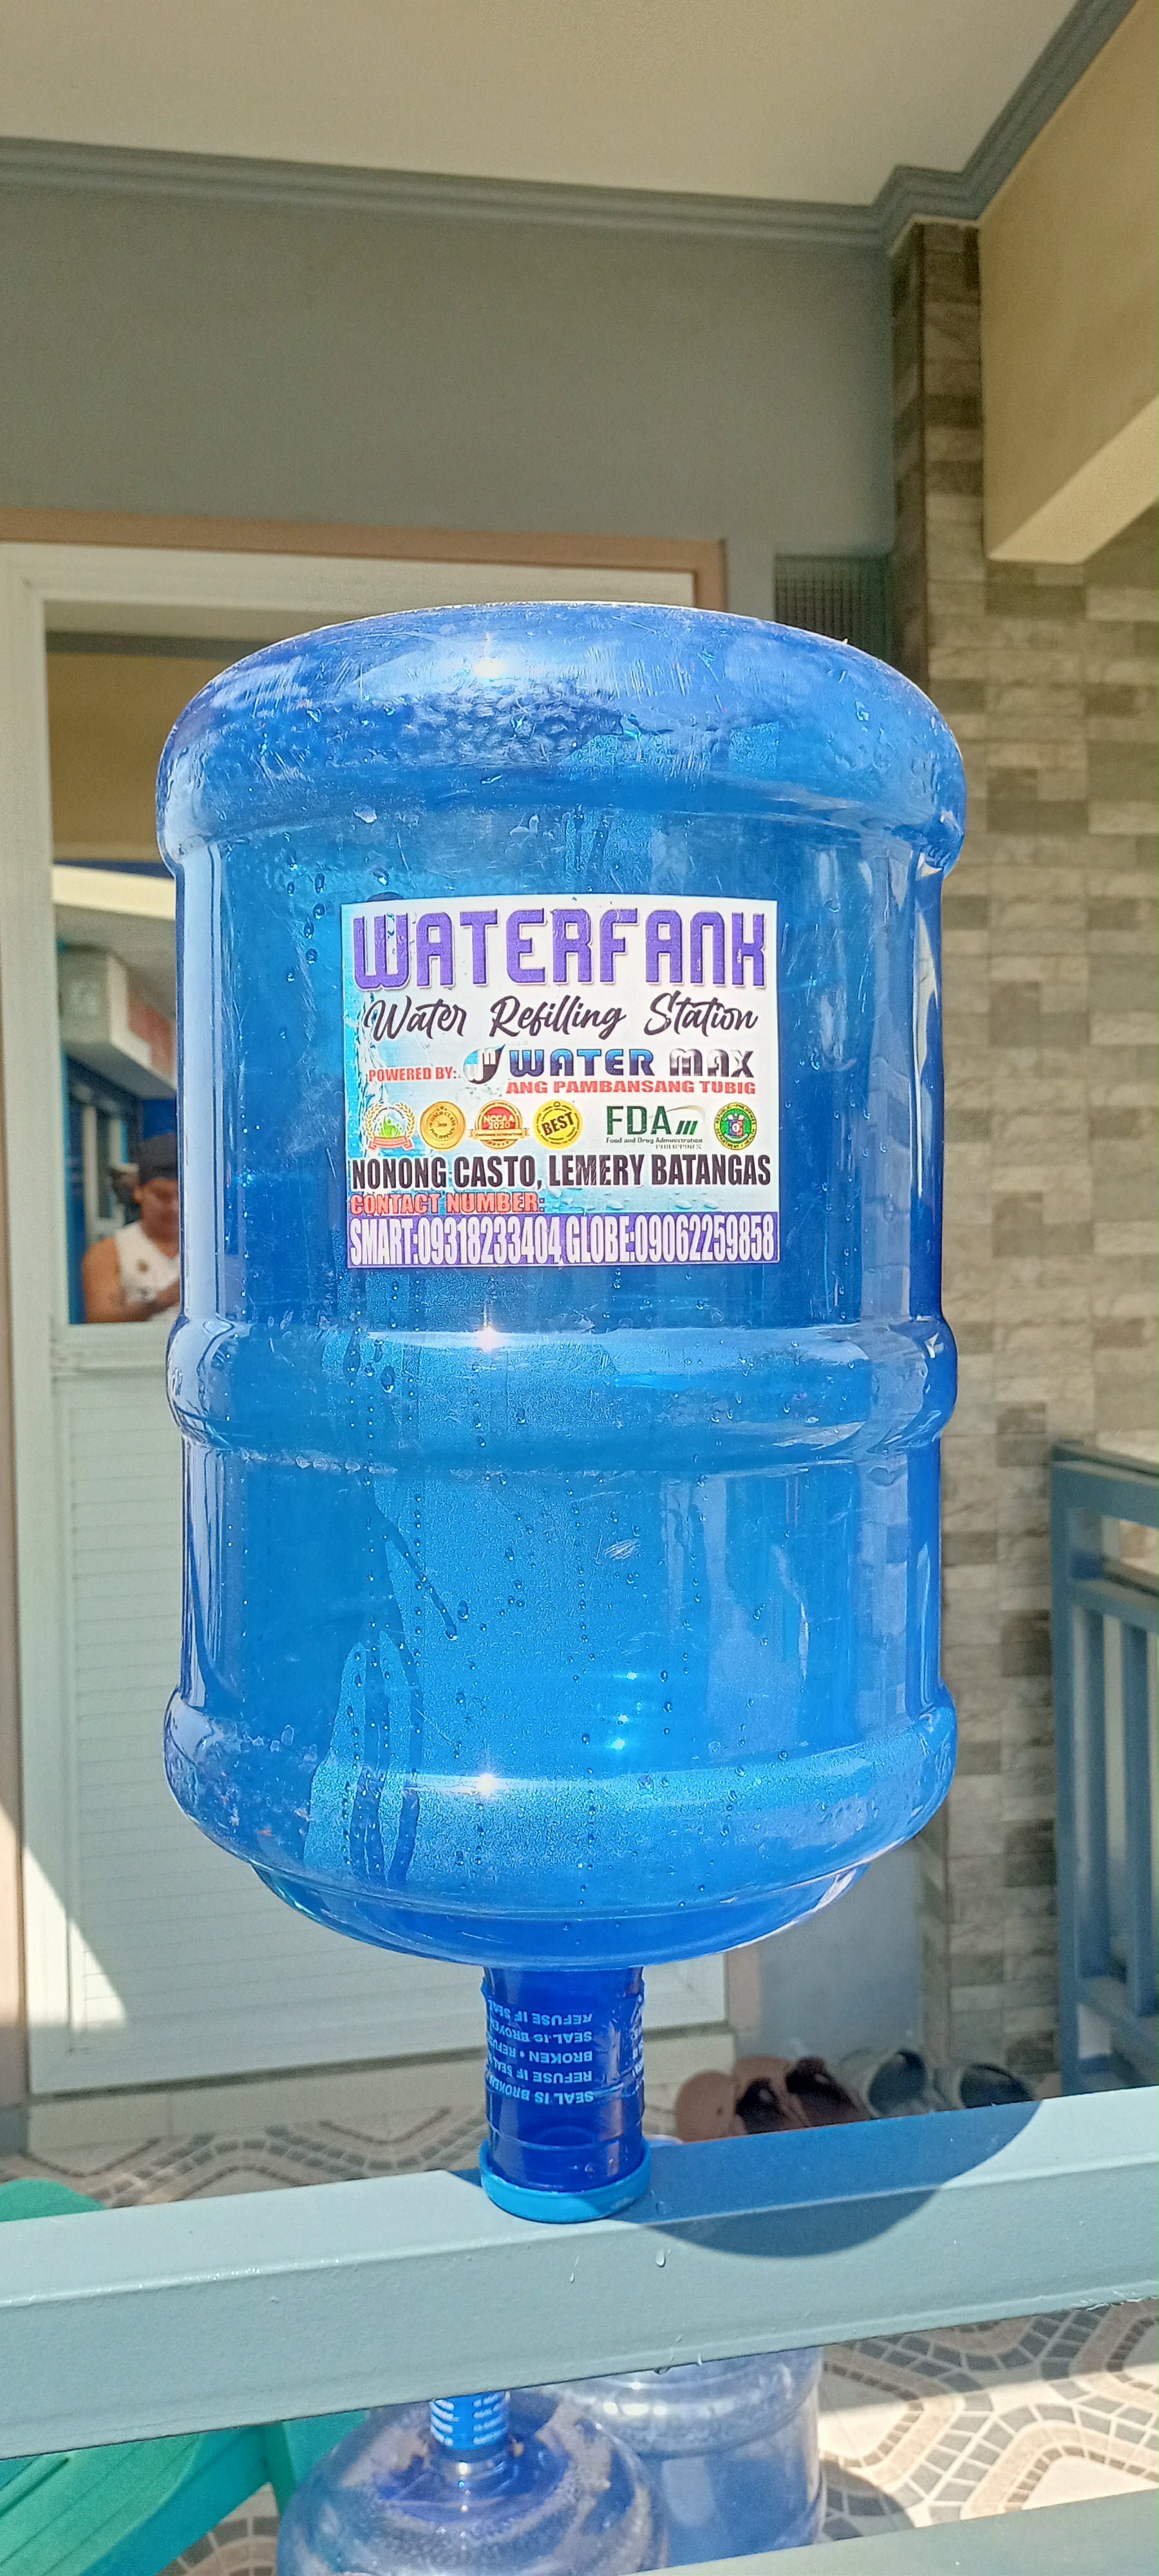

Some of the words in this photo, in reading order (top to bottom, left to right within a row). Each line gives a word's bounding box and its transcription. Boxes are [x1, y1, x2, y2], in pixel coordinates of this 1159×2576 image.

[353, 907, 766, 989] WATERFANK
[364, 999, 467, 1041] Water
[489, 995, 627, 1039] Refilling
[644, 991, 758, 1036] Station
[509, 1048, 654, 1078] WATER
[669, 1048, 755, 1078] MAX
[369, 1067, 431, 1082] POWERED
[435, 1066, 457, 1079] BY:
[506, 1081, 547, 1094] ANG
[554, 1080, 694, 1094] PAMBANSANG
[697, 1079, 756, 1094] TUBIG
[484, 1114, 515, 1123] NCCAA
[541, 1112, 574, 1136] BEST
[607, 1106, 672, 1135] FDA
[352, 1156, 449, 1189] NONONG
[451, 1155, 543, 1190] CASTO,
[549, 1153, 645, 1186] LEMERY
[652, 1153, 771, 1186] BATANGAS
[350, 1193, 439, 1215] CONTACT
[446, 1191, 545, 1214] NUMBER:
[487, 1999, 511, 2019] SEAL
[514, 2011, 528, 2023] IF
[532, 2012, 592, 2026] REFUSE
[533, 2033, 549, 2043] IS
[553, 2031, 592, 2044] SEAL
[529, 2050, 593, 2064] BROKEN
[493, 2056, 513, 2077] SEAL
[516, 2069, 529, 2081] IF
[532, 2070, 592, 2084] REFUSE
[489, 2074, 531, 2101] BROKEN
[534, 2091, 550, 2105] IS
[554, 2090, 594, 2105] SEAL
